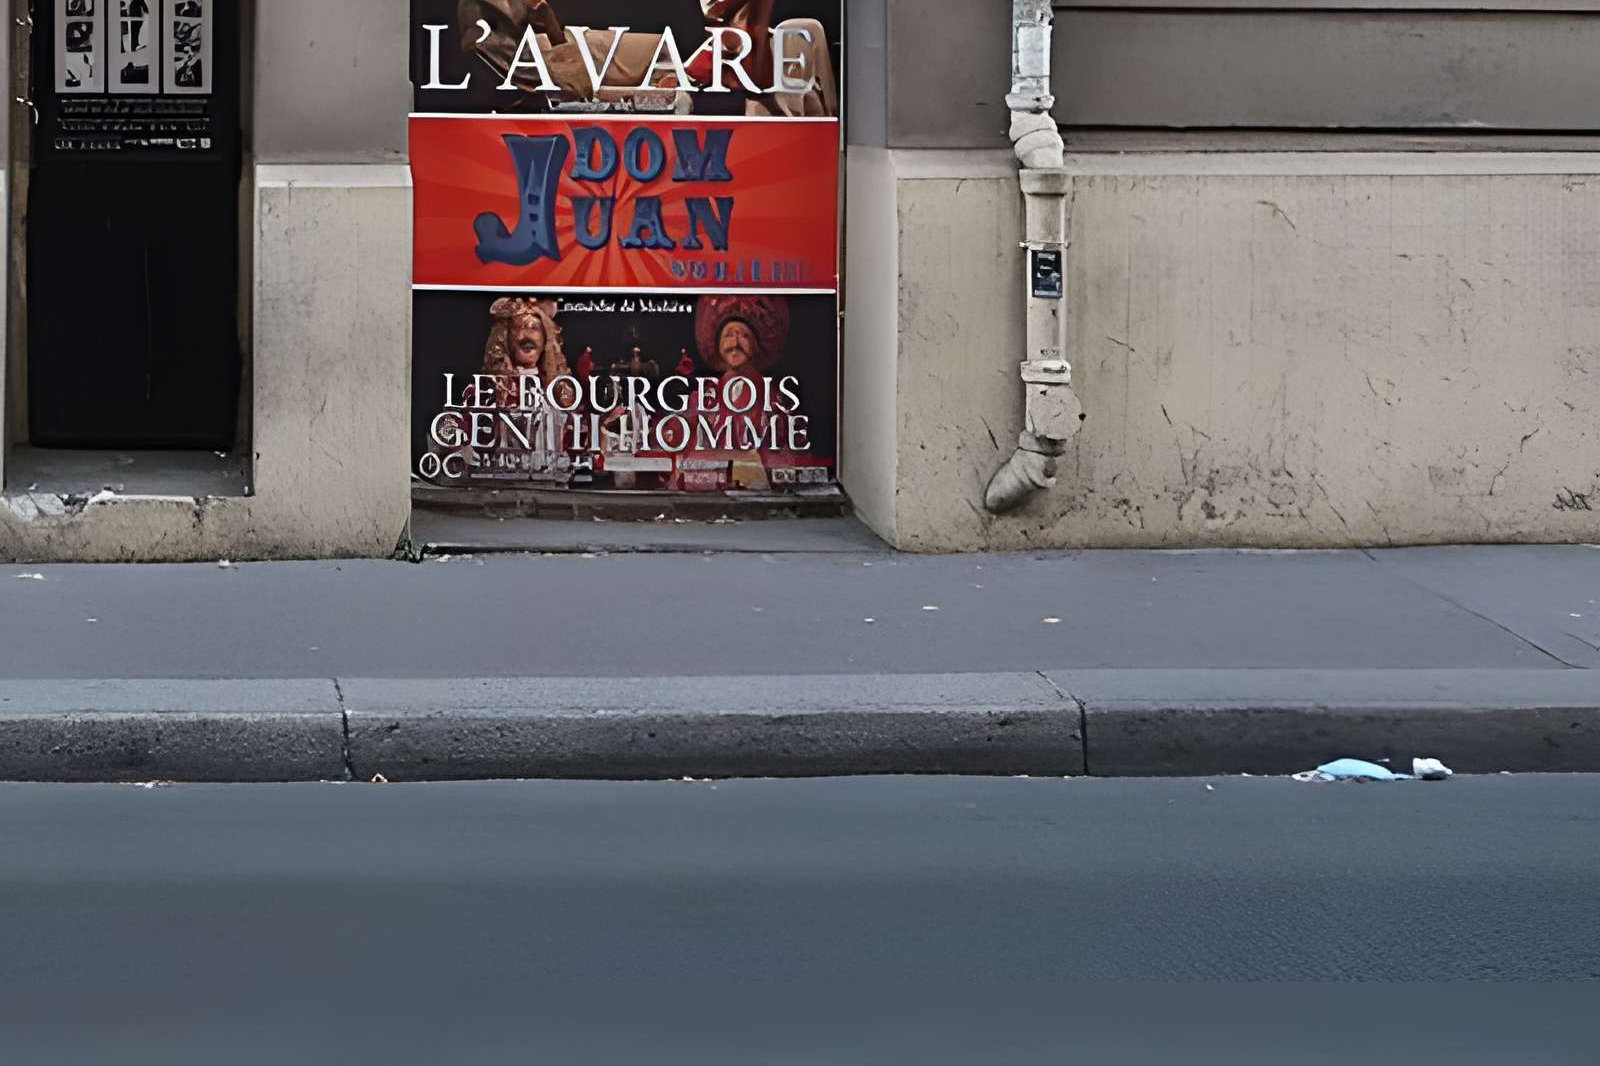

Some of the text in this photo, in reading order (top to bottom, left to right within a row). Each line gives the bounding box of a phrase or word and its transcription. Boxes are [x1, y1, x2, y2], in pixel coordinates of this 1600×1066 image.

[420, 19, 818, 94] L'AVARE
[568, 126, 734, 183] DOM
[443, 373, 801, 413] LE BOURGEOIS
